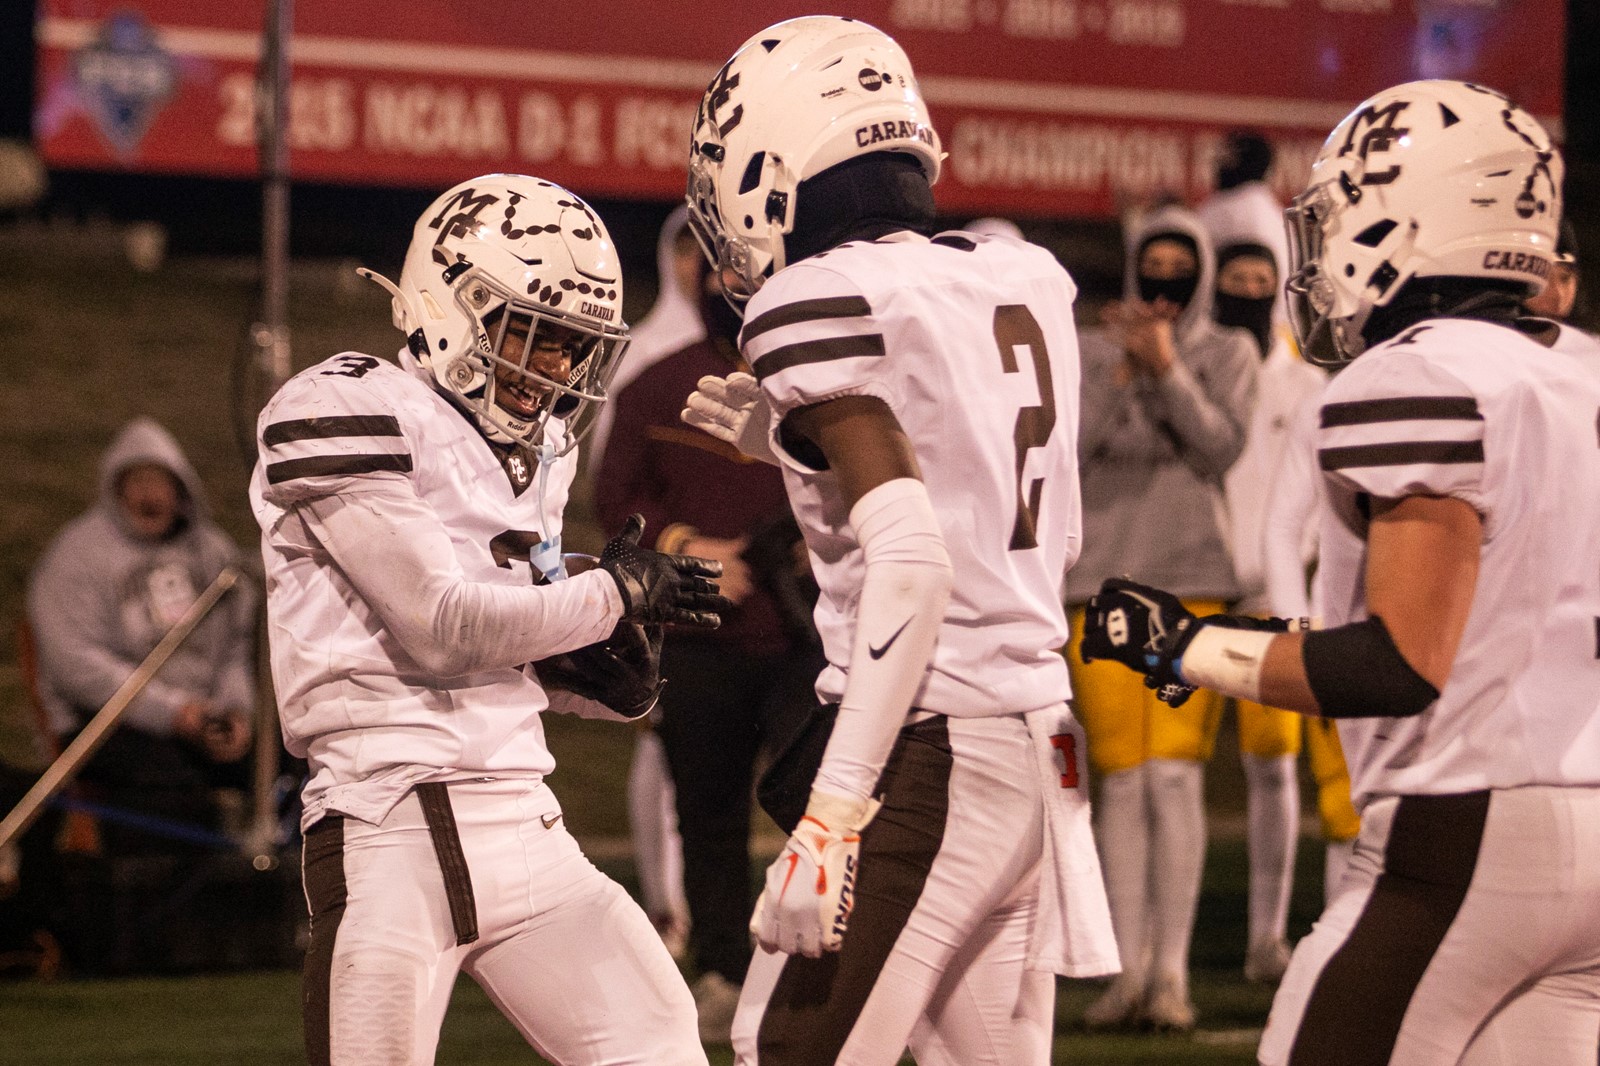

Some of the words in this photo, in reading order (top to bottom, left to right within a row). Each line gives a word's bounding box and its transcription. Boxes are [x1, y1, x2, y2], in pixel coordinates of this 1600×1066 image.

[216, 72, 356, 150] 215
[364, 82, 509, 159] NCAA
[581, 302, 615, 322] CARAVAN
[565, 358, 591, 386] iddell
[508, 457, 528, 484] MC
